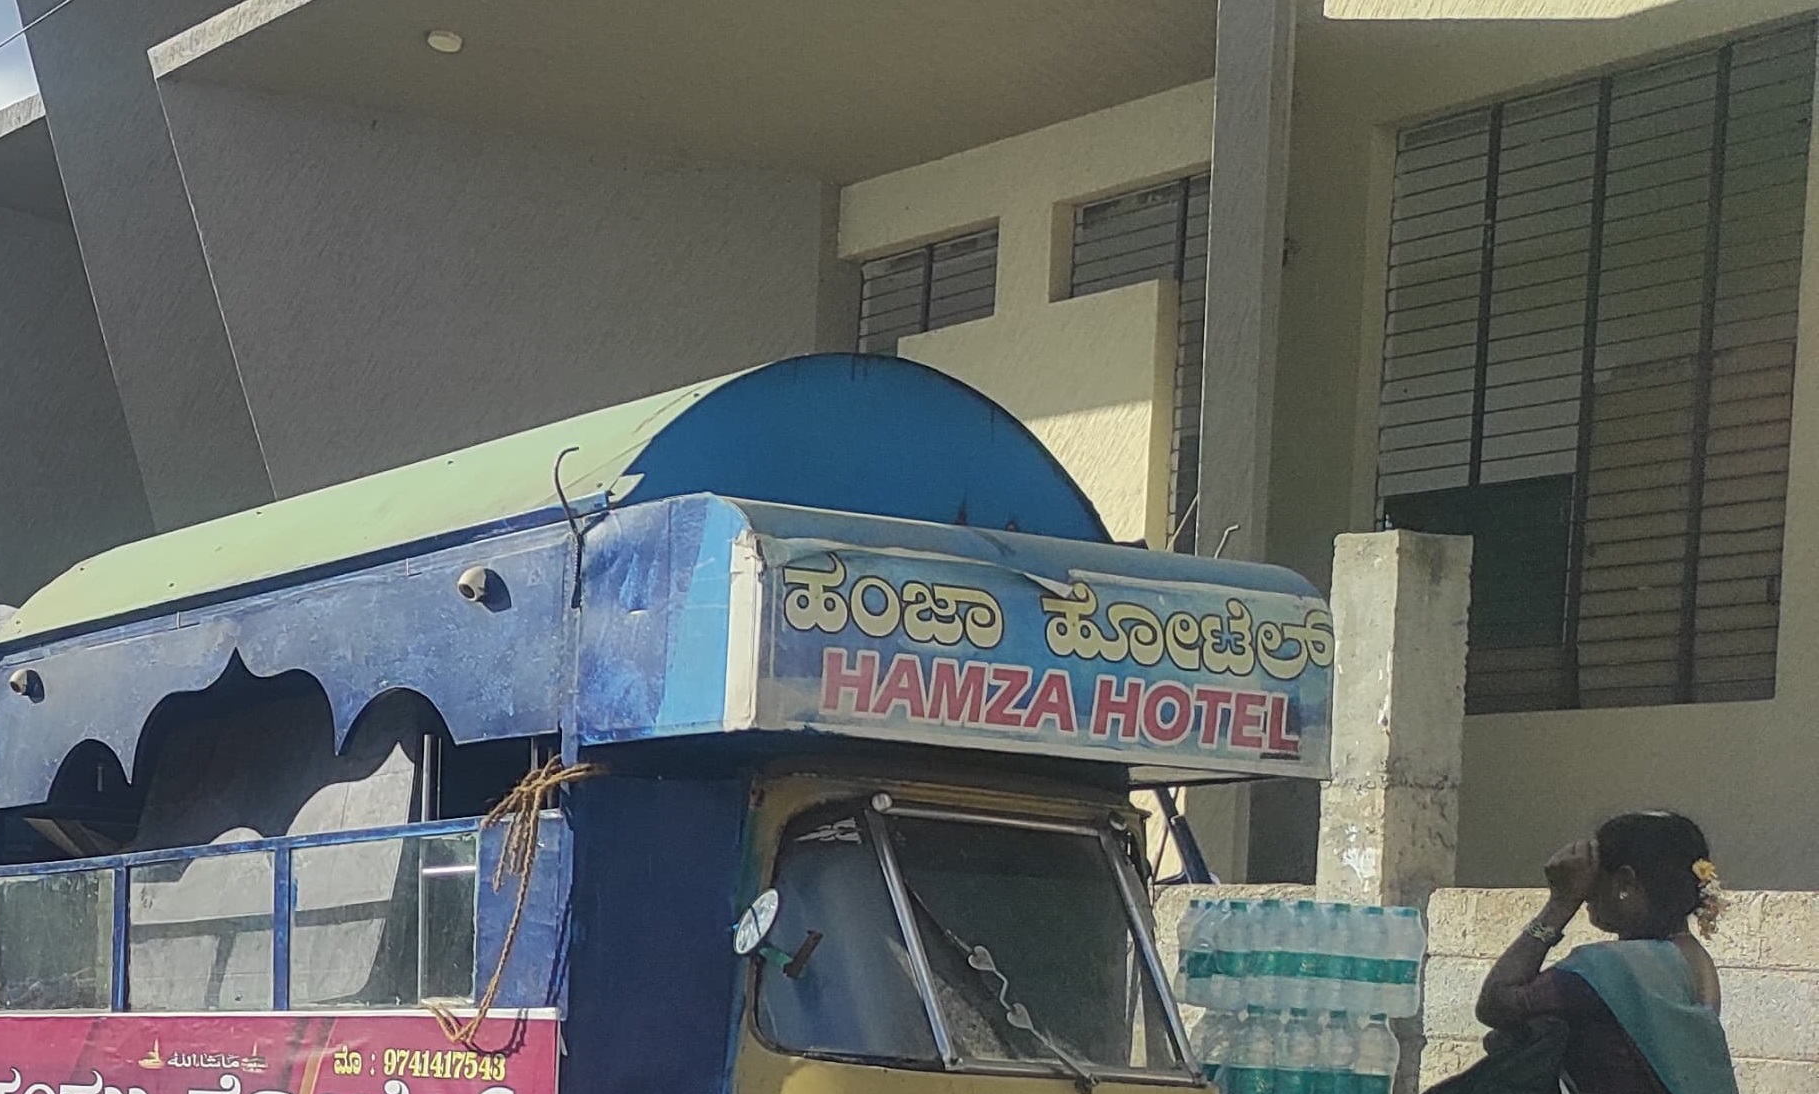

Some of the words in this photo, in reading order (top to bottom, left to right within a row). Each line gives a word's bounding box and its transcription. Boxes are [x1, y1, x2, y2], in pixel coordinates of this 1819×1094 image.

[782, 550, 1005, 650] ಹಂಜಾ
[1040, 581, 1334, 680] ಹೋಟೆಲ್
[819, 647, 1077, 735] HAMZA
[1090, 673, 1300, 753] HOTEL
[383, 1048, 506, 1081] 9741417543
